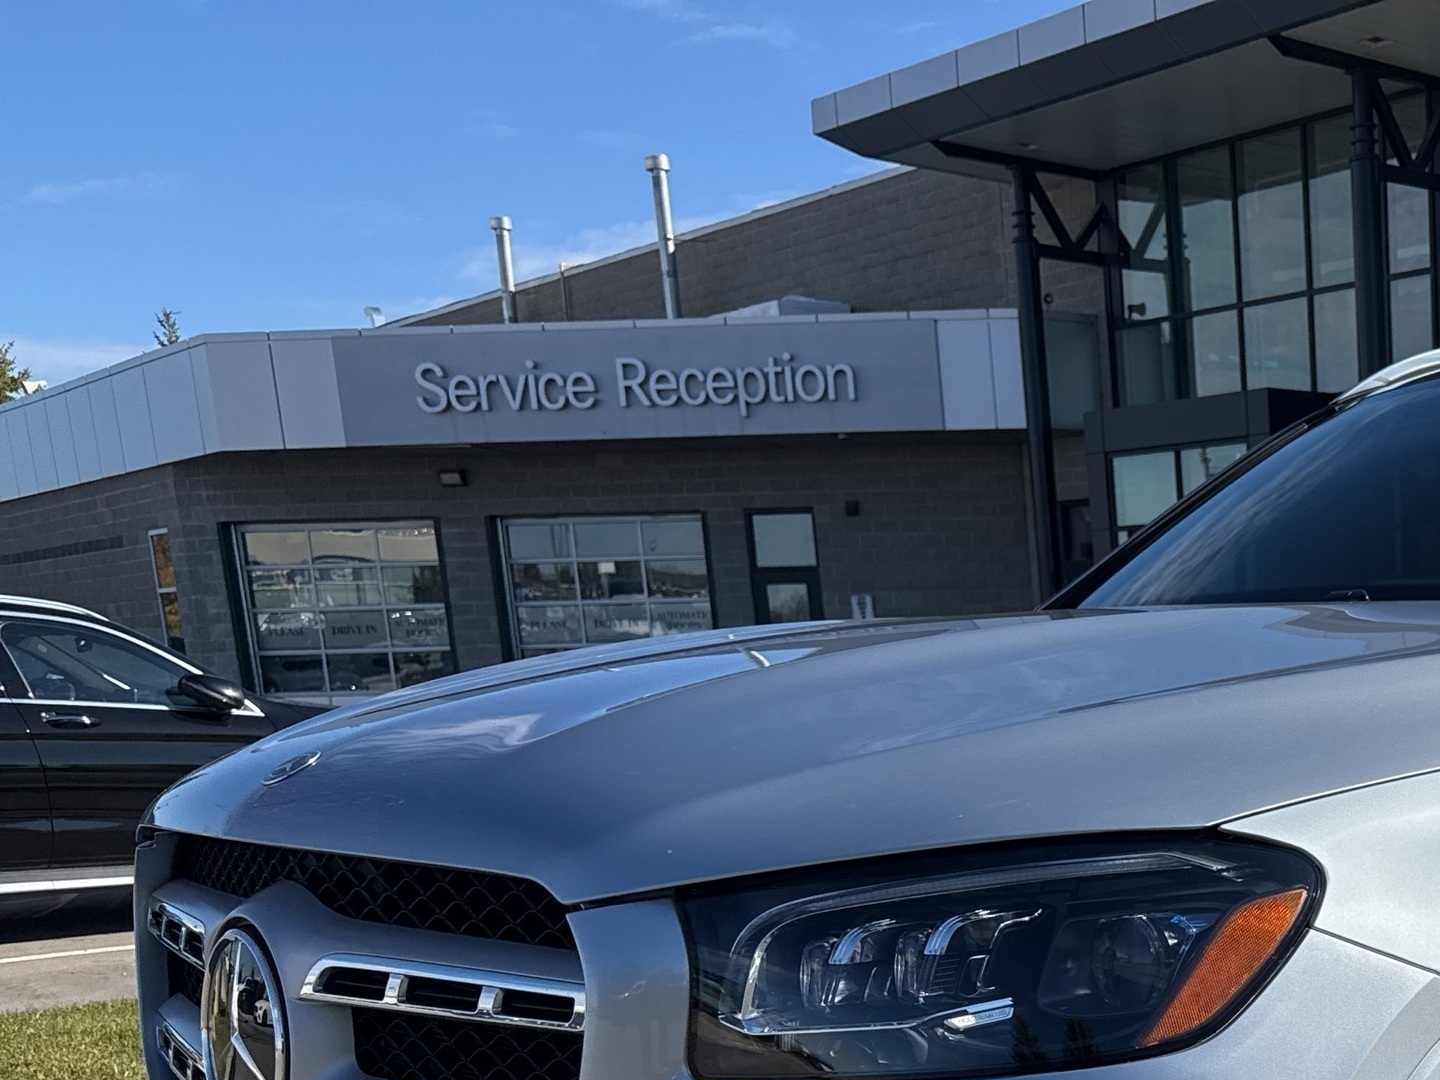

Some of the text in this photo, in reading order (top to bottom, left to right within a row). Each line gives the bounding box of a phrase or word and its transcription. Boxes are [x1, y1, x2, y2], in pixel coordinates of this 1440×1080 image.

[414, 352, 857, 417] Service Reception
[331, 625, 364, 636] DRIVE
[366, 624, 378, 635] IN
